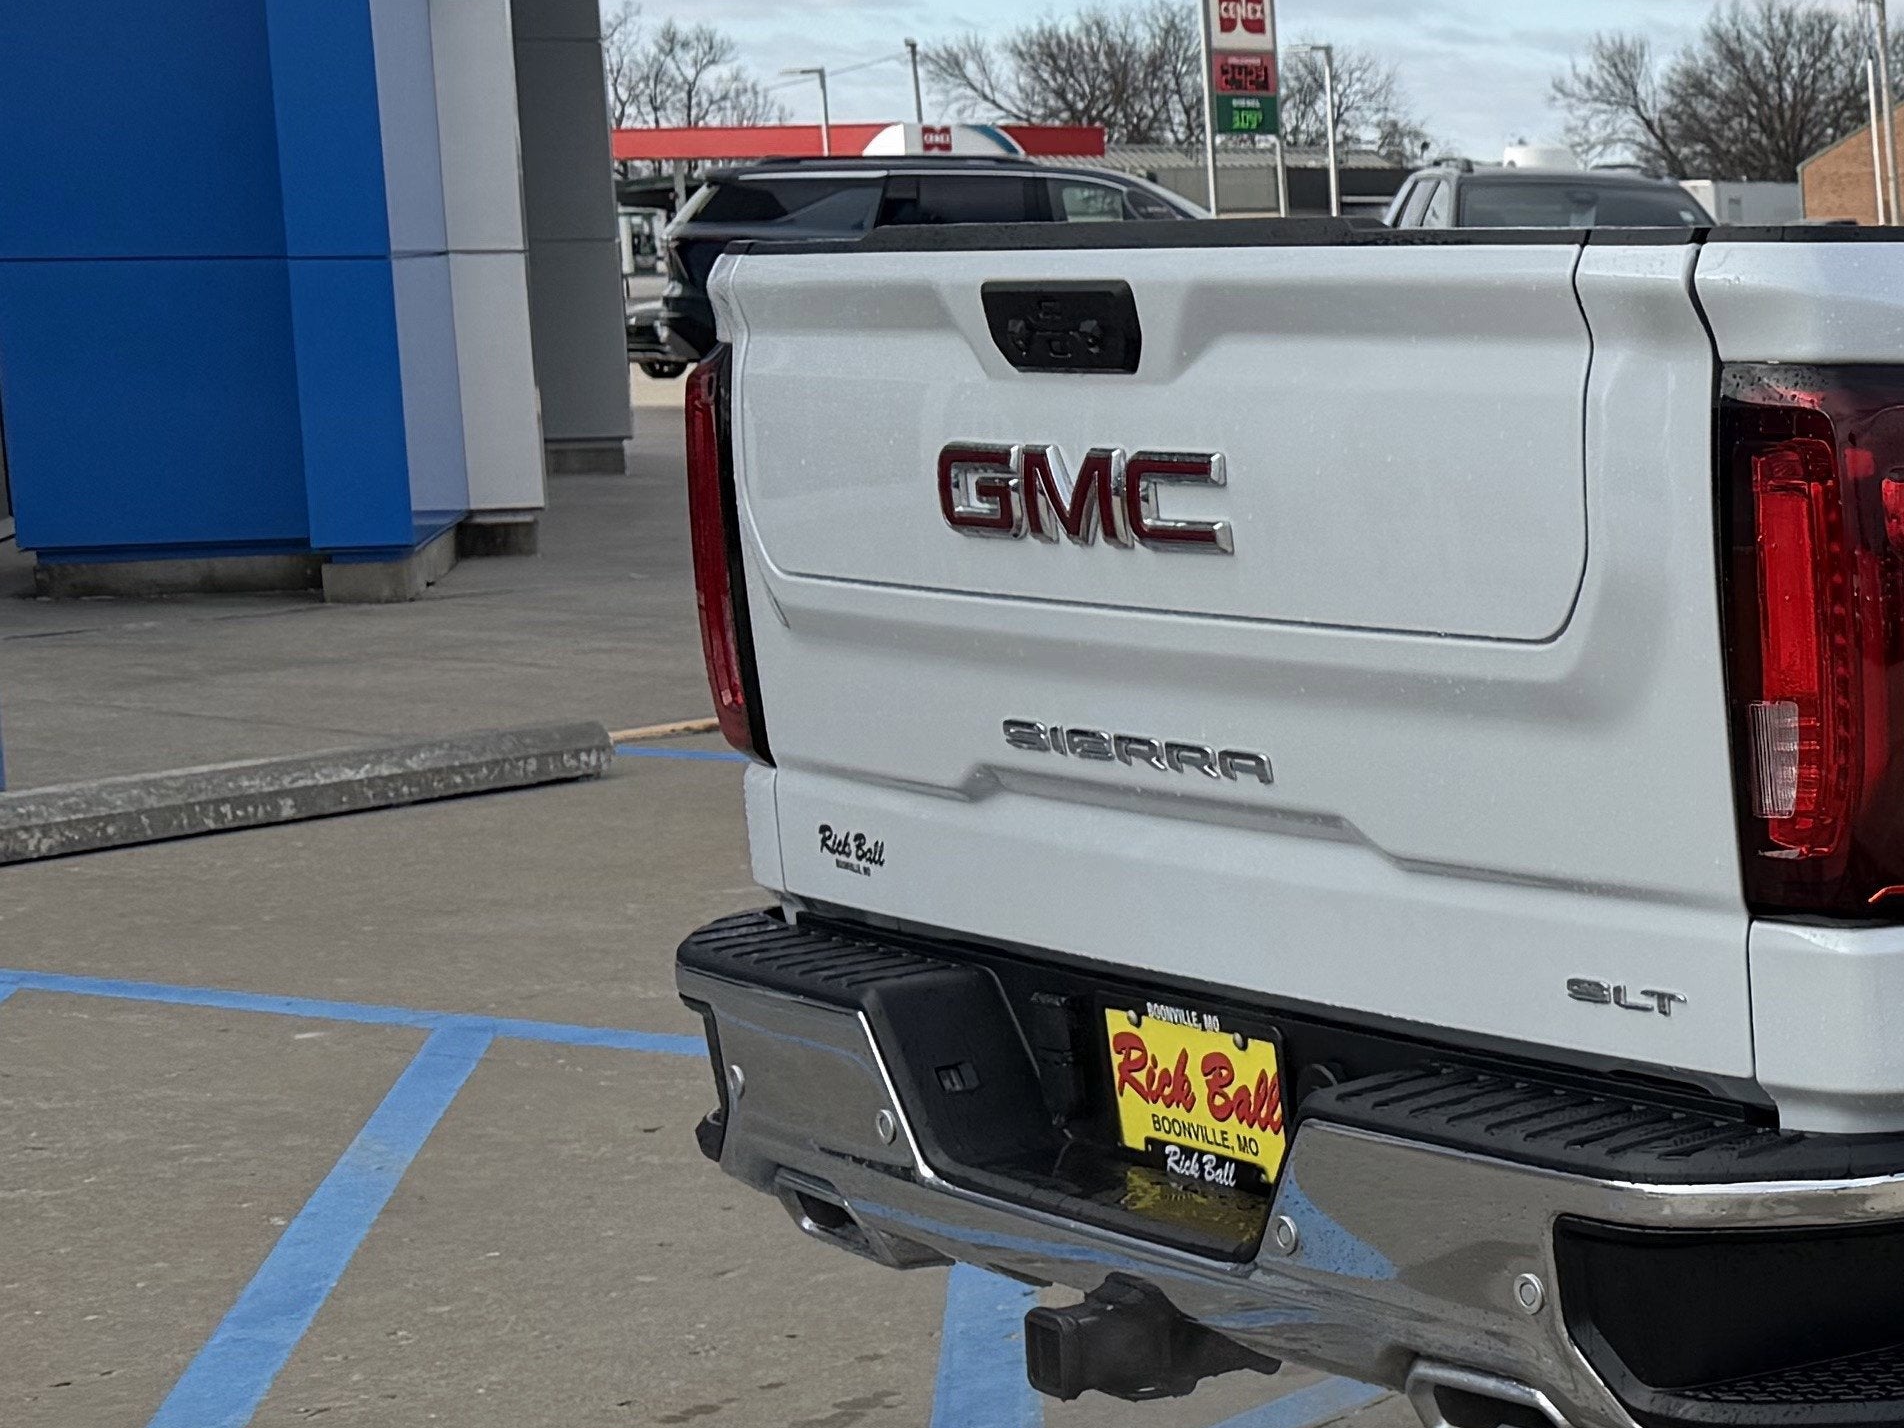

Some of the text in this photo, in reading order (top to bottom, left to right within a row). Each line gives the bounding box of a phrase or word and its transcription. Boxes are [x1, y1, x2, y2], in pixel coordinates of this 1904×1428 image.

[1219, 0, 1265, 21] CENEX
[937, 442, 1234, 555] GMC
[1002, 719, 1275, 785] SIERRA
[853, 833, 885, 867] Ball
[1566, 978, 1688, 1017] SLT
[1112, 1032, 1284, 1136] Rick Ball
[1152, 1113, 1260, 1157] BOONVILLE, MO
[1165, 1145, 1237, 1187] Rick Ball
